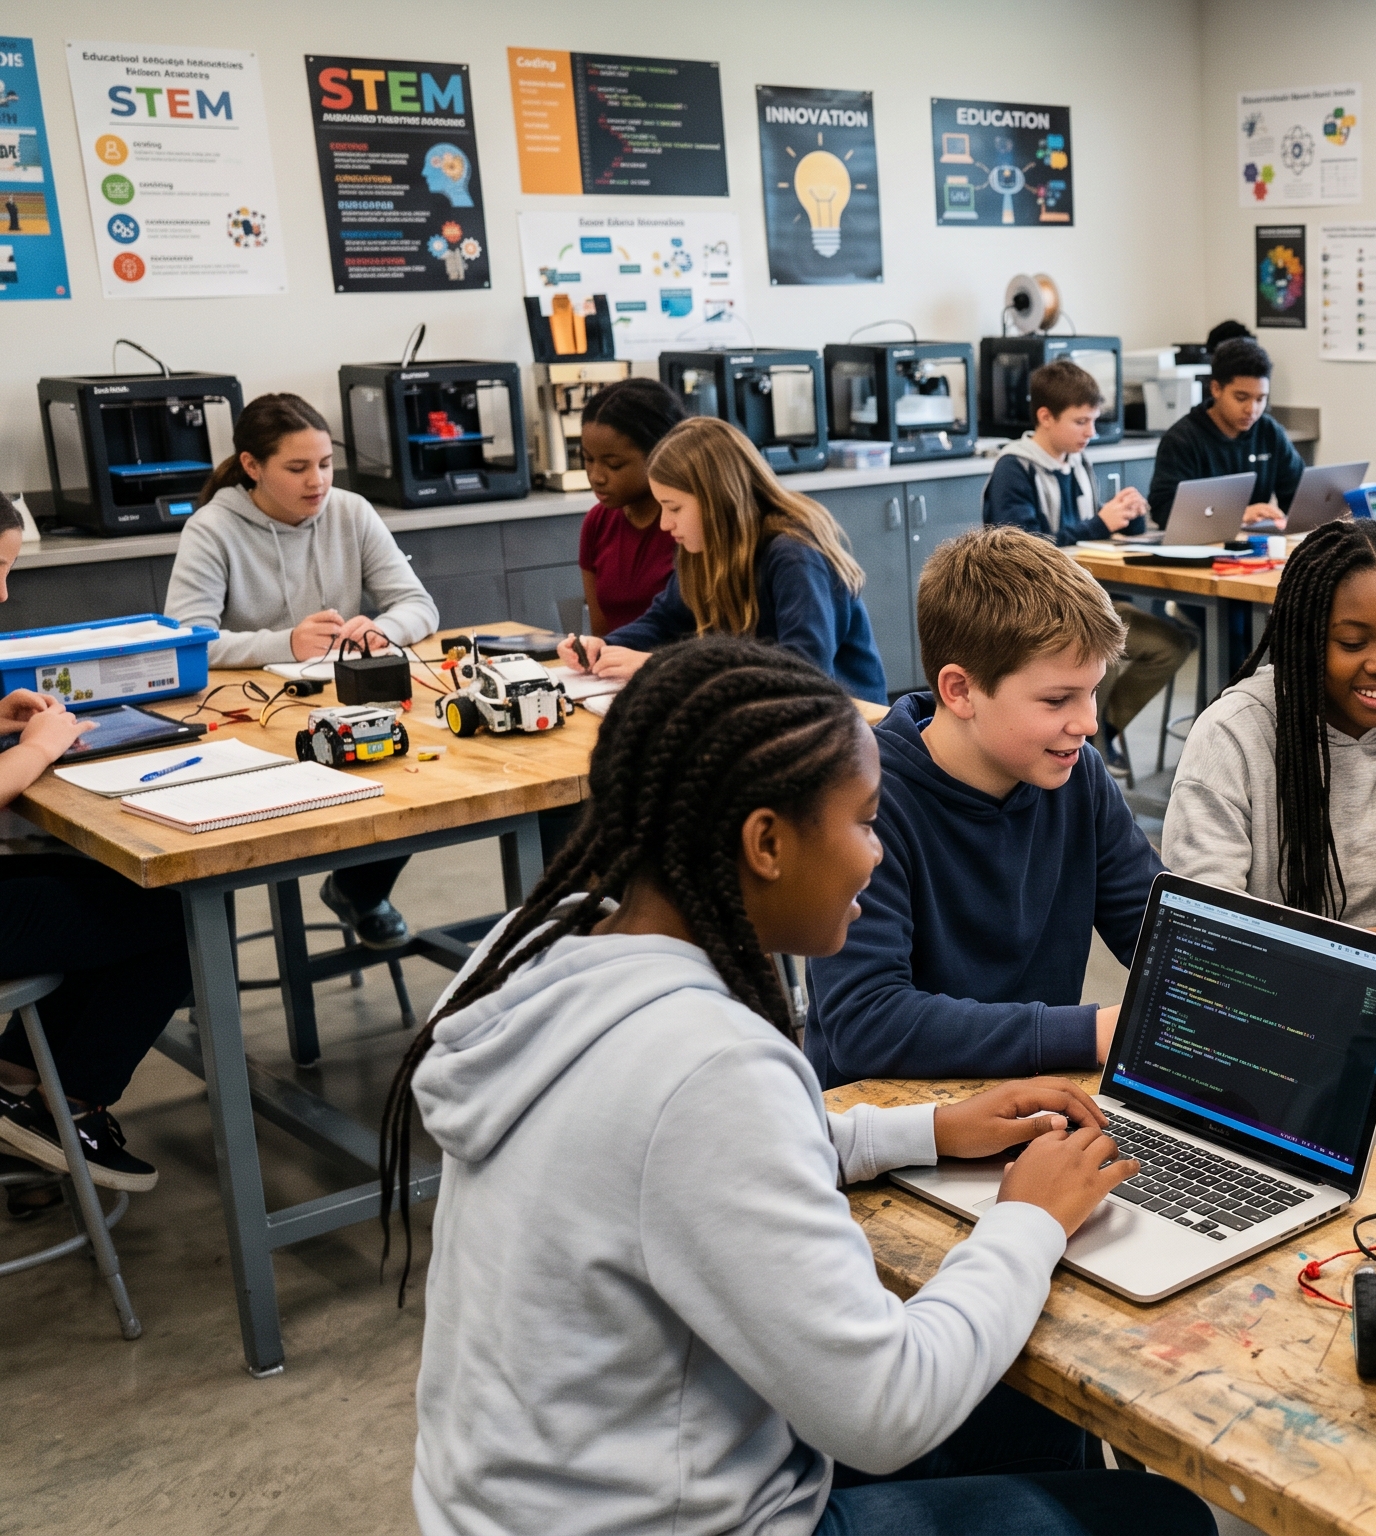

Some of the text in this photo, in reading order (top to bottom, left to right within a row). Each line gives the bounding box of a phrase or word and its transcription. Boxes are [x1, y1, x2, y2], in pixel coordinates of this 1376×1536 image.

[108, 85, 233, 120] STEM
[318, 67, 466, 115] STEM
[765, 105, 869, 128] INNOVATION
[956, 107, 1051, 130] EDUCATION
